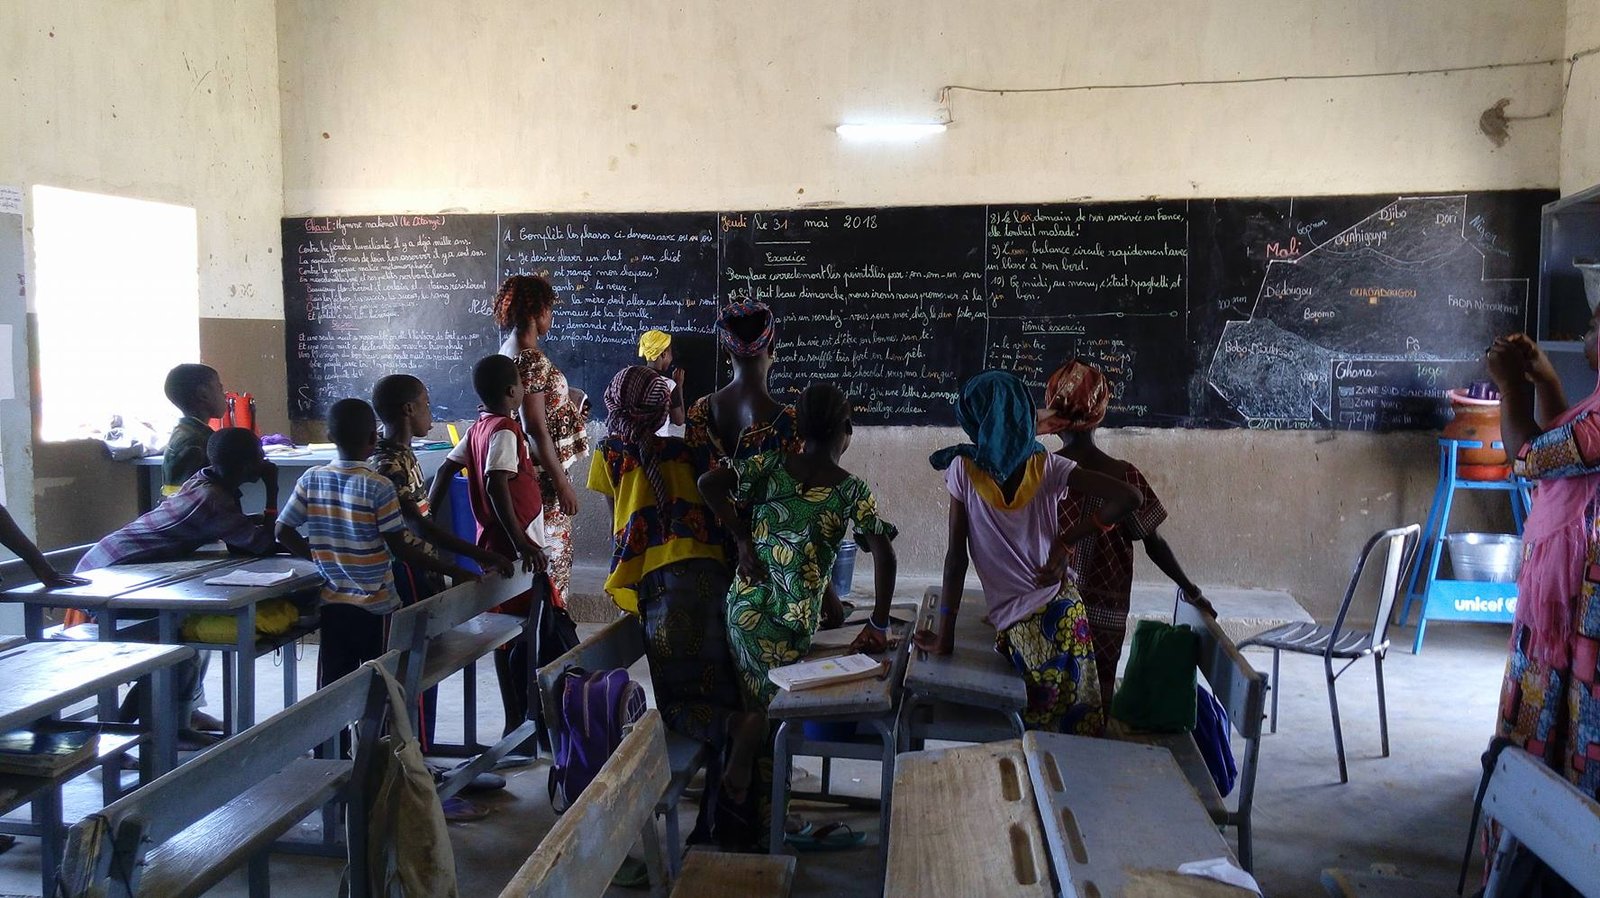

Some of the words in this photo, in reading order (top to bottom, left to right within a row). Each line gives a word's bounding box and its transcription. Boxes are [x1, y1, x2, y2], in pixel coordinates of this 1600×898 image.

[1107, 210, 1142, 222] arrivée
[1379, 204, 1407, 222] Djibo
[1435, 210, 1457, 224] Dori
[721, 214, 747, 232] Jeudi
[773, 218, 788, 230] 31
[804, 217, 829, 228] mai
[843, 215, 878, 229] 2018
[519, 226, 564, 251] Complète
[580, 224, 610, 247] phrases
[1266, 236, 1302, 258] Mali
[601, 249, 622, 262] chat
[1042, 262, 1059, 271] son
[585, 293, 605, 304] mère
[607, 294, 624, 305] doit
[626, 293, 646, 306] aller
[551, 307, 589, 316] nimaux
[1303, 307, 1336, 319] Boromo
[1335, 360, 1375, 379] Ghana
[1454, 595, 1504, 613] unicef
